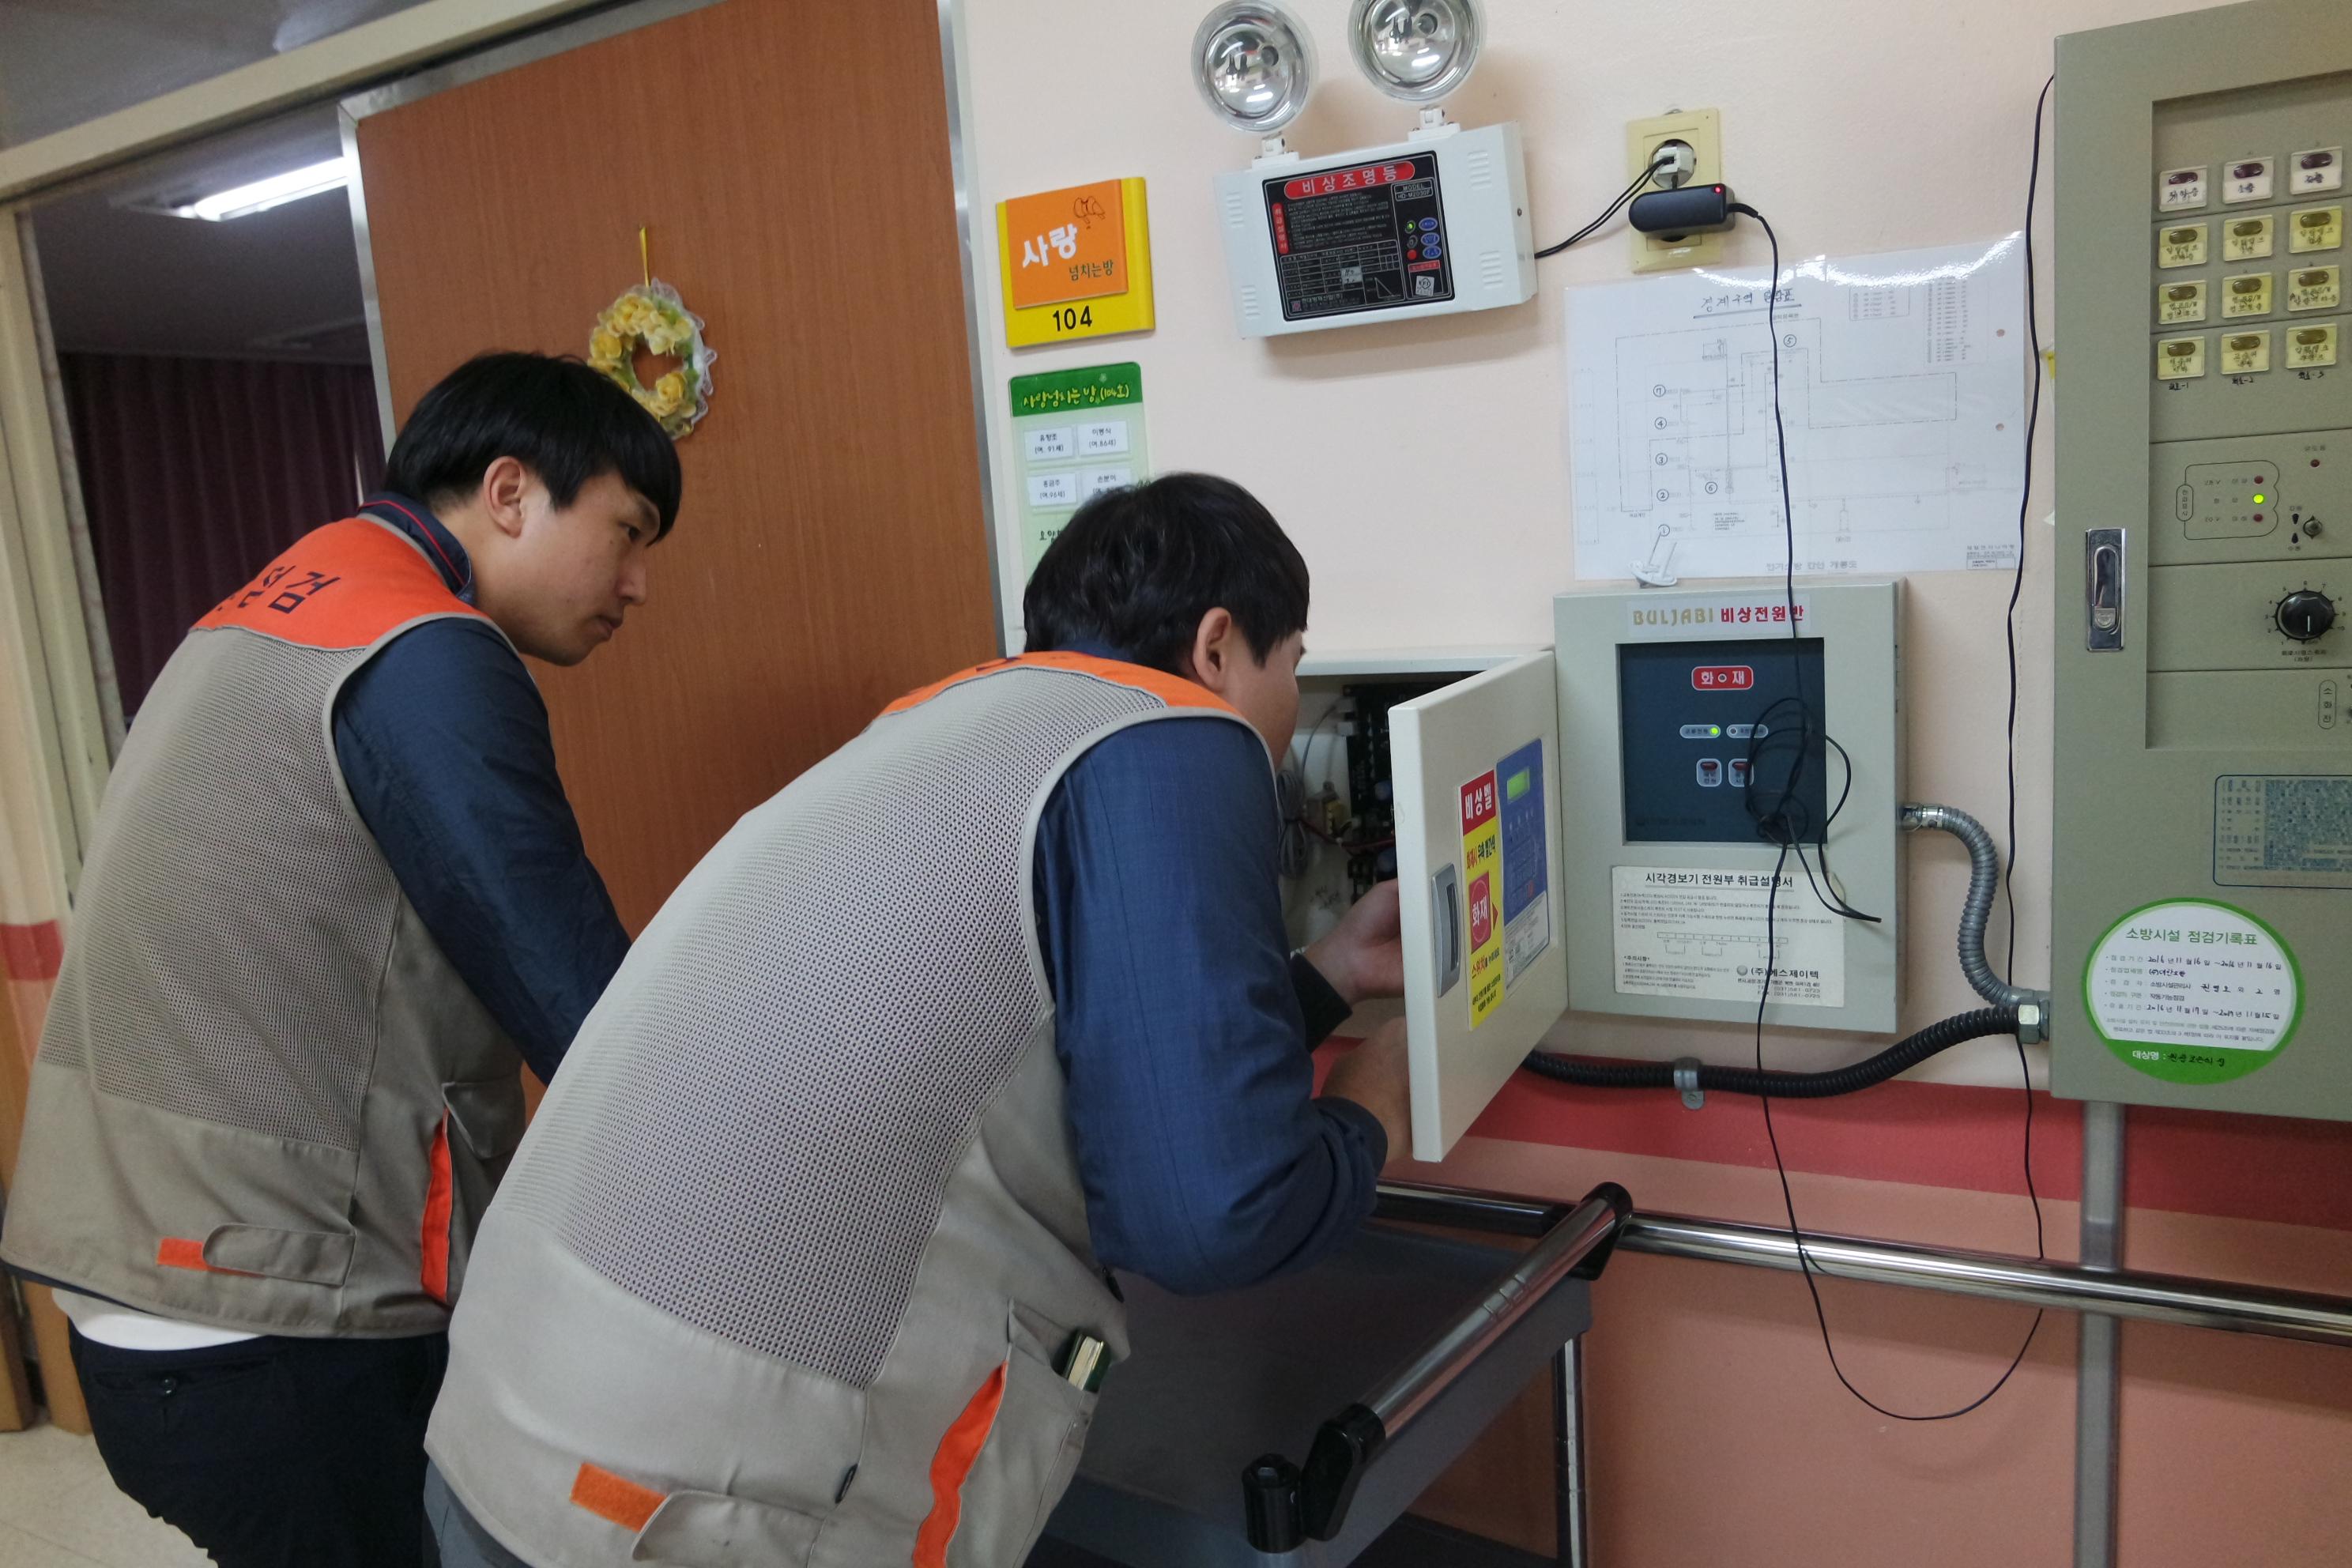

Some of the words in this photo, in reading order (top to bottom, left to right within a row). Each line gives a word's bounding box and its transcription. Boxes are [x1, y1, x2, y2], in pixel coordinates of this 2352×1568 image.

[1302, 165, 1397, 194] 비상조명등
[1023, 223, 1077, 268] 사랑
[1069, 260, 1114, 281] 넘치는방
[1701, 292, 1753, 312] 경계구역
[1053, 306, 1092, 331] 104
[1766, 562, 1802, 571] 전기방
[1633, 608, 1713, 626] BULJABI
[1721, 605, 1804, 624] 비상전원반
[1464, 782, 1492, 820] 비상벨
[1645, 873, 1698, 884] 시각경보기
[1702, 874, 1734, 885] 전원부
[1472, 895, 1489, 926] 화재
[2126, 928, 2180, 942] 소방시설
[2188, 931, 2257, 944] 점검기록표
